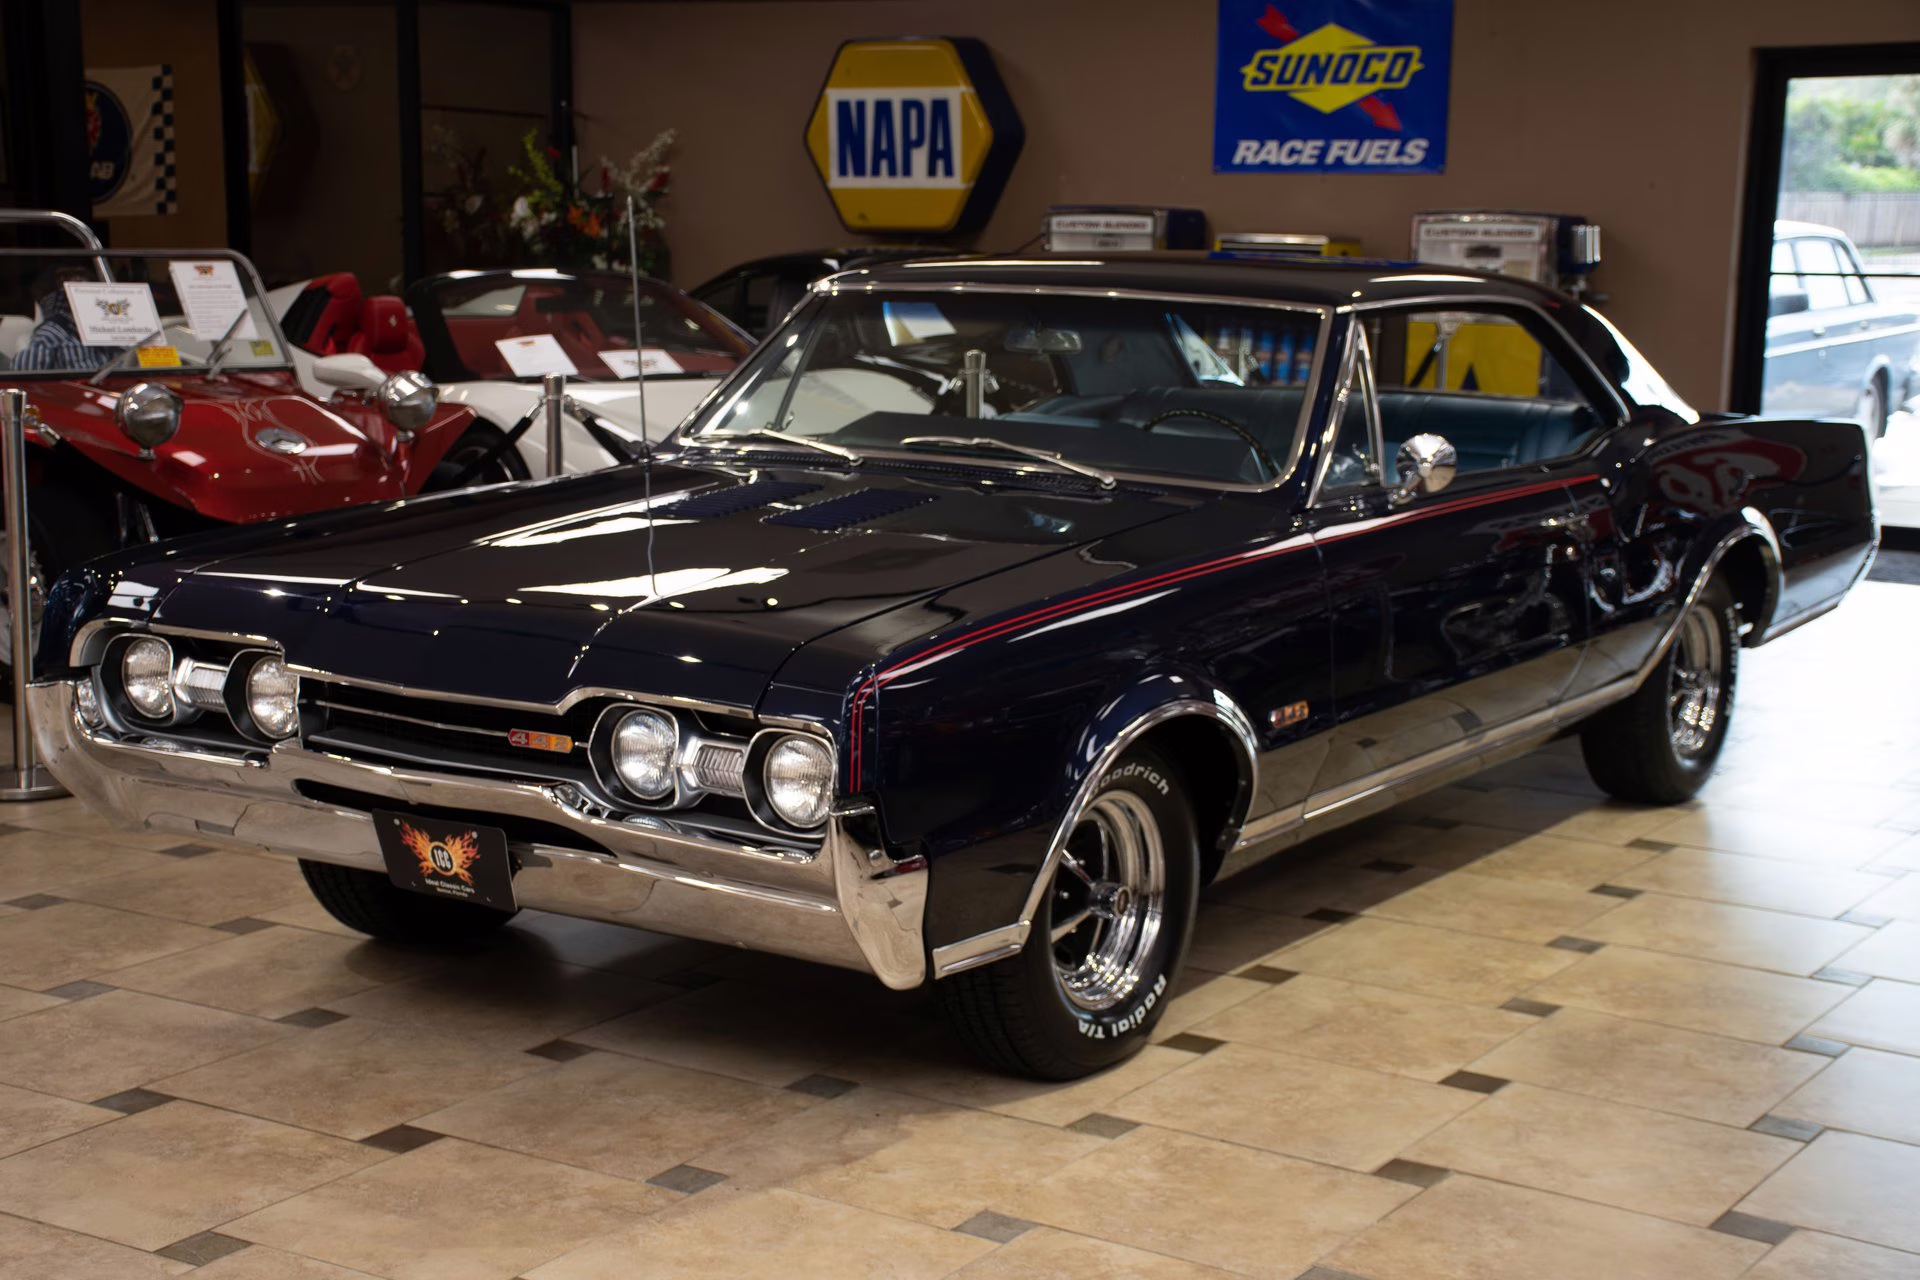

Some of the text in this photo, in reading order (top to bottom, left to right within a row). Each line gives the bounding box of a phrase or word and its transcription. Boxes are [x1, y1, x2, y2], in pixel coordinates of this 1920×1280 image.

[1248, 51, 1416, 86] SUNOCO
[836, 98, 955, 178] NAPA
[1231, 138, 1430, 166] RACE FUELS
[512, 732, 569, 751] 442
[1090, 762, 1170, 796] oodrich
[433, 847, 452, 870] ICC
[1078, 973, 1167, 1038] Radial T/A
